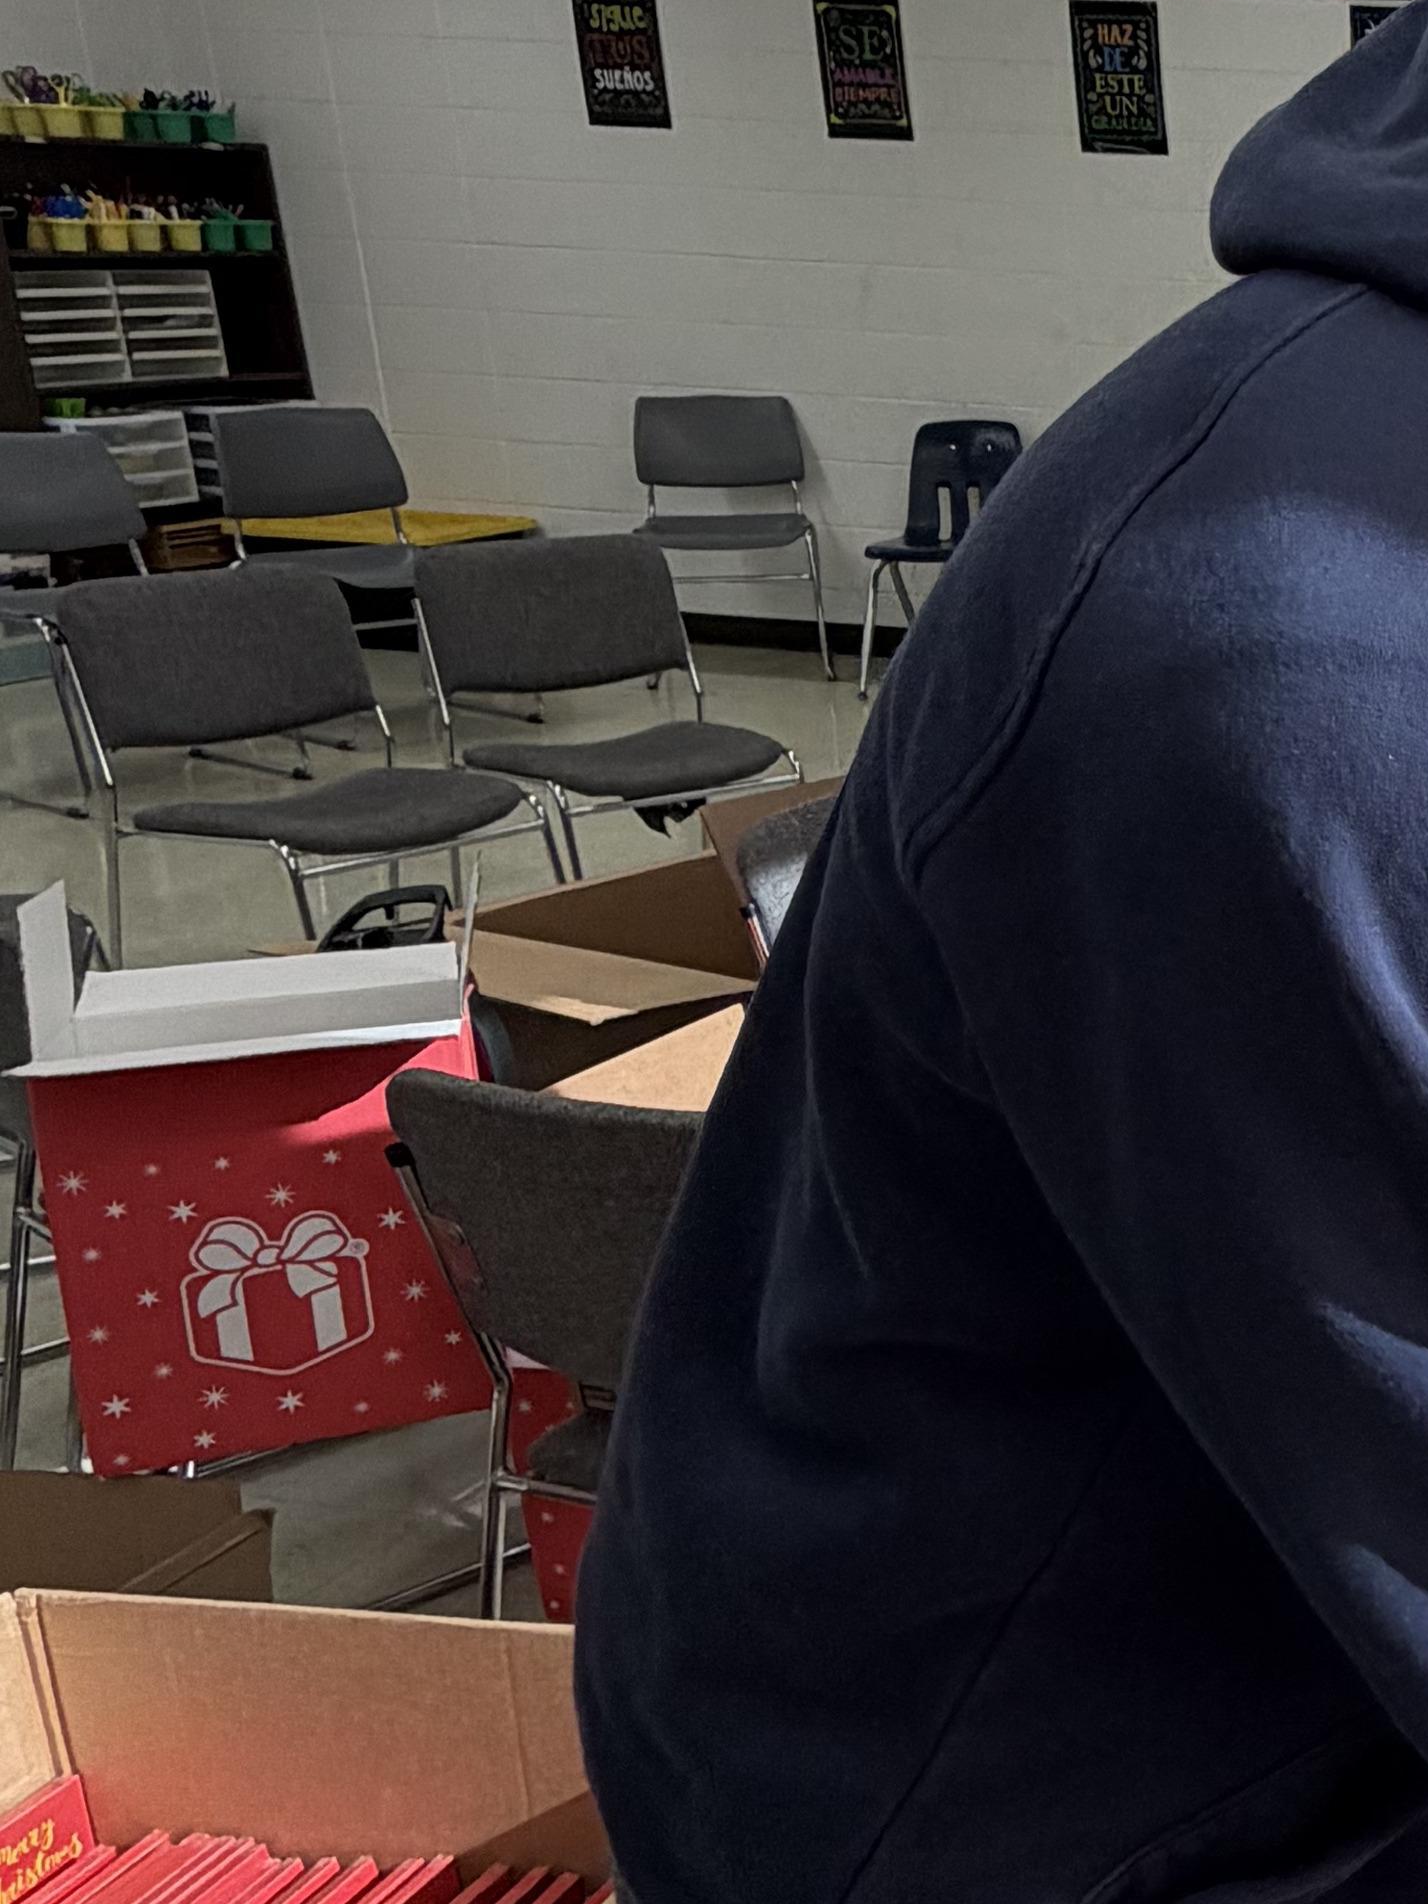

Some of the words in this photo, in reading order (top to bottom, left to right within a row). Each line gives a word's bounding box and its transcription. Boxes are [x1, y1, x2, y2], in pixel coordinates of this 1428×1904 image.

[1097, 24, 1132, 45] HAZ
[1104, 48, 1128, 71] DE
[594, 66, 654, 92] SUEÑOS
[1095, 74, 1145, 94] ESTE
[835, 87, 898, 102] SIEMPRE
[1105, 97, 1138, 116] UN
